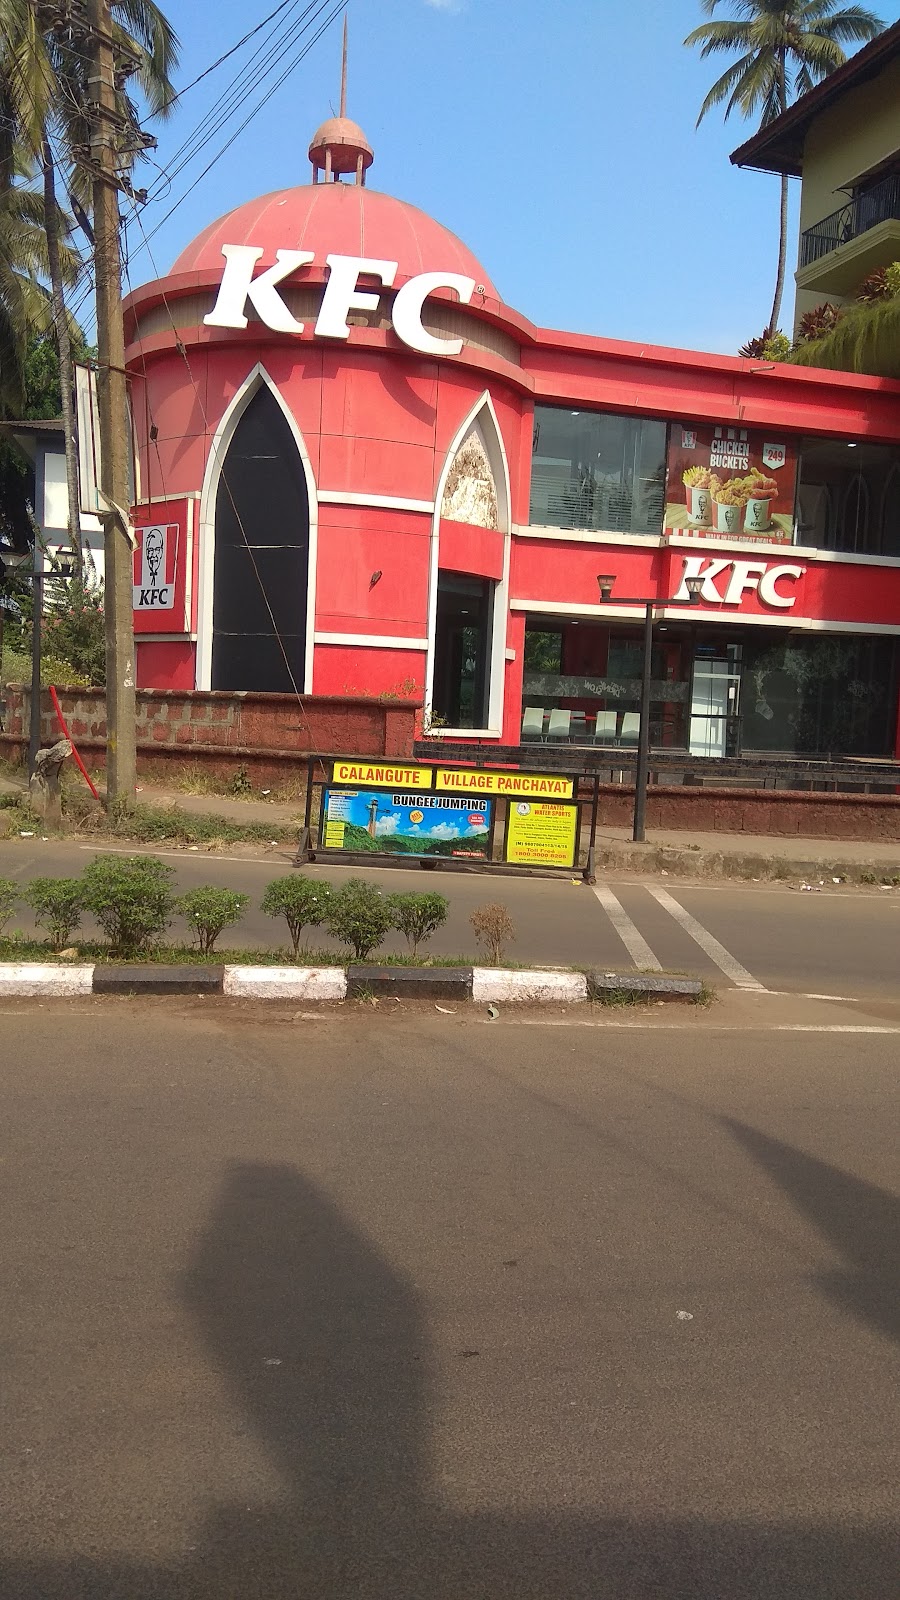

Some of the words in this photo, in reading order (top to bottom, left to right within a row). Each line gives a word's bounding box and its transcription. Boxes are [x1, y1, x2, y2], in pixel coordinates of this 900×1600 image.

[203, 244, 476, 355] KFC
[711, 440, 750, 457] CHICKEN
[710, 454, 749, 470] BUCKETS
[673, 557, 803, 607] KFC
[139, 588, 168, 605] KFC
[339, 766, 420, 784] CALANGUTE
[443, 774, 493, 789] VILLAGE
[498, 778, 569, 794] PANCHAYAT
[393, 795, 435, 808] BUNGEE
[438, 798, 486, 811] JUMPING
